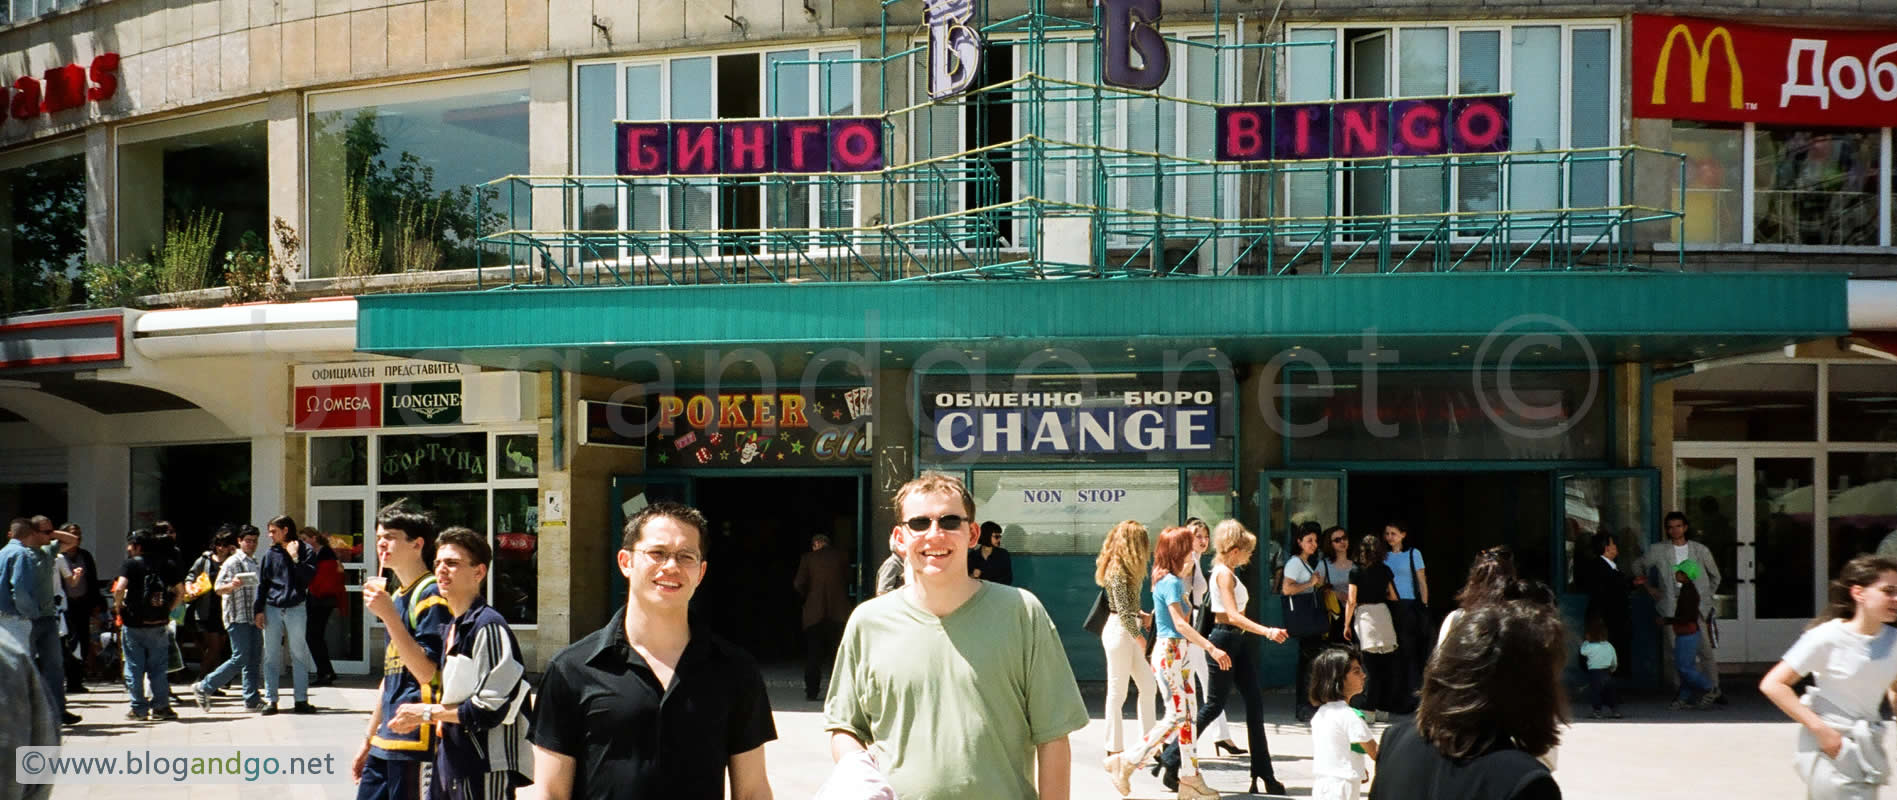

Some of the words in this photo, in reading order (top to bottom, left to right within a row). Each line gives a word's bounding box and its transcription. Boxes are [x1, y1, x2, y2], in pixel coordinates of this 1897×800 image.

[1779, 38, 1897, 110] Доб
[1227, 102, 1502, 157] BINGO
[627, 124, 877, 172] БИНГО
[312, 367, 375, 380] ОФИЦИАЛЕН
[323, 396, 371, 412] OMEGA
[658, 394, 809, 429] POKER
[935, 393, 1083, 407] ОБМЕННО
[1124, 391, 1213, 405] БЮРО
[936, 410, 1211, 452] CHANGE
[1024, 490, 1062, 503] NON
[1078, 489, 1126, 503] STOP
